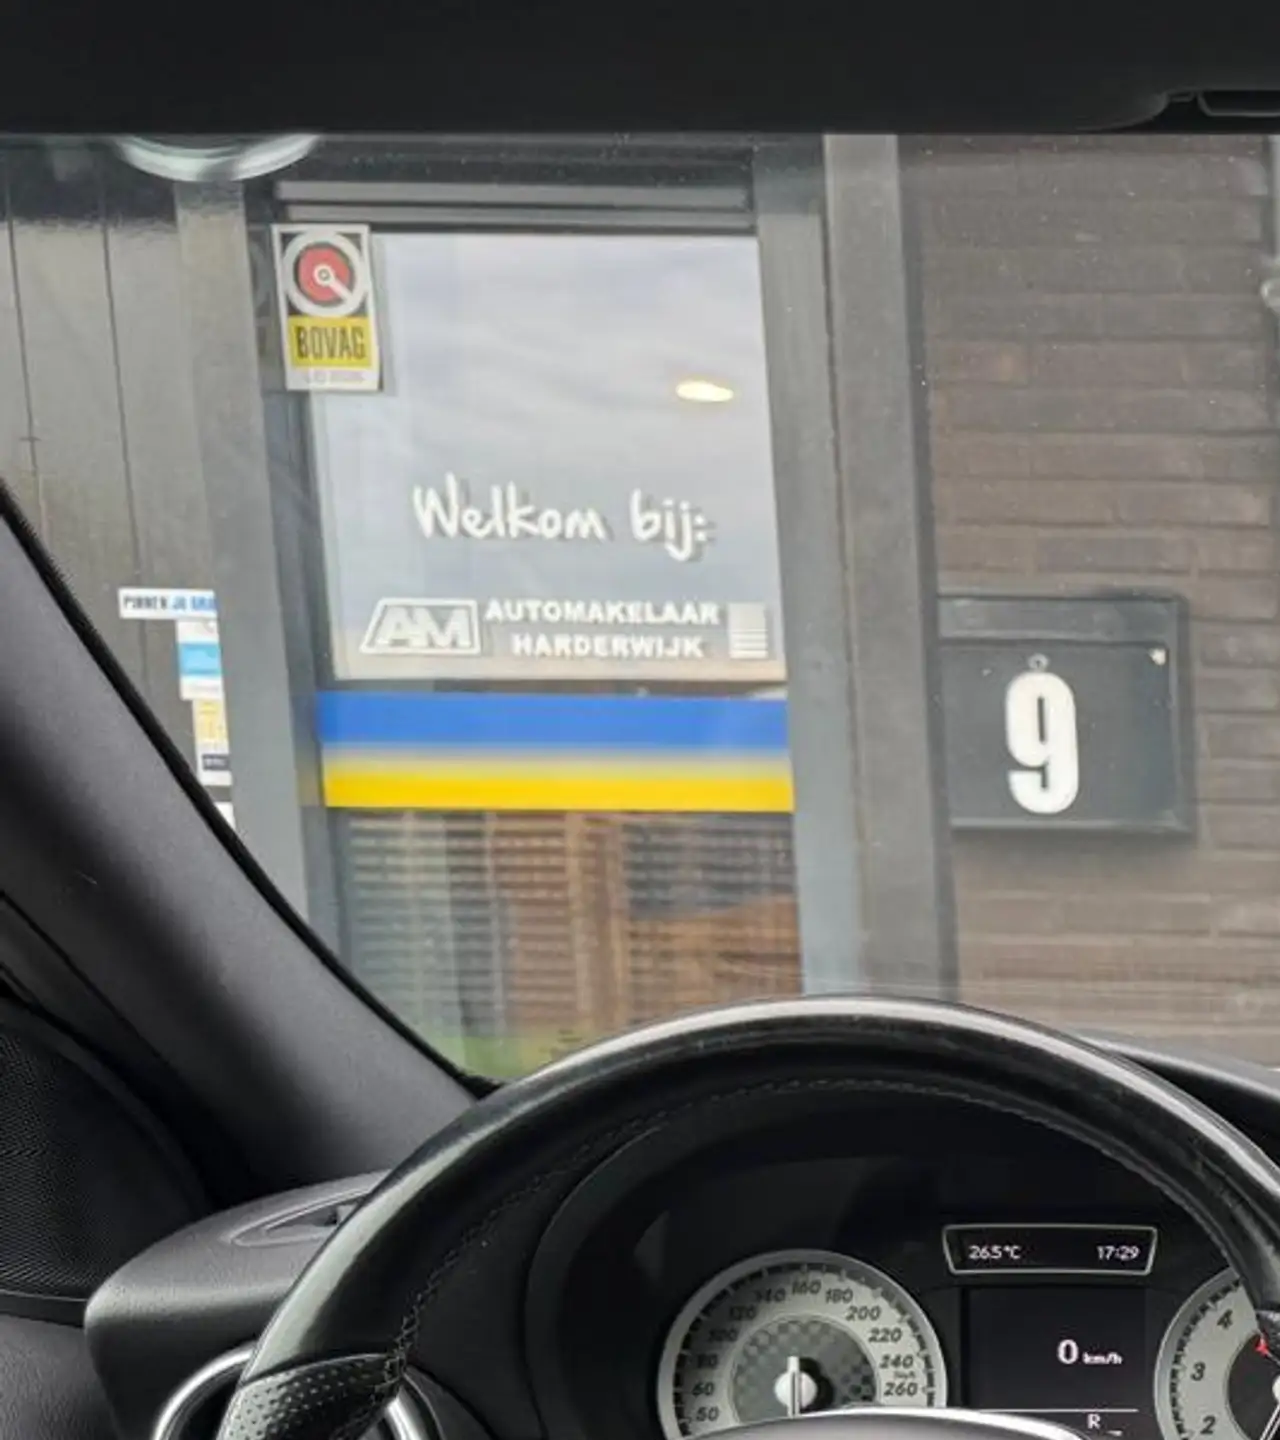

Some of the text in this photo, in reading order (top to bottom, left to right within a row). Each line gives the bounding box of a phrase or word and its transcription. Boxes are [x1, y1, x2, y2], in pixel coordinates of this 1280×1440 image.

[294, 325, 367, 360] BOVAG
[413, 472, 709, 561] Welkom bij:
[485, 601, 721, 624] AUTOMAKELAAR
[374, 608, 474, 648] AM
[513, 632, 704, 658] HARDERWIJK
[1006, 672, 1079, 814] 9
[1096, 1245, 1140, 1260] 17:29
[792, 1280, 821, 1294] 160
[825, 1289, 853, 1304] 180
[846, 1306, 882, 1320] 200
[1217, 1310, 1234, 1331] 4
[869, 1328, 902, 1342] 220
[1057, 1339, 1123, 1365] 0 km/h
[879, 1355, 914, 1369] 240
[1190, 1361, 1206, 1381] 3
[692, 1382, 715, 1397] 60
[883, 1382, 918, 1397] 260
[696, 1406, 719, 1422] 50
[1088, 1414, 1101, 1429] R
[1201, 1416, 1217, 1435] 2
